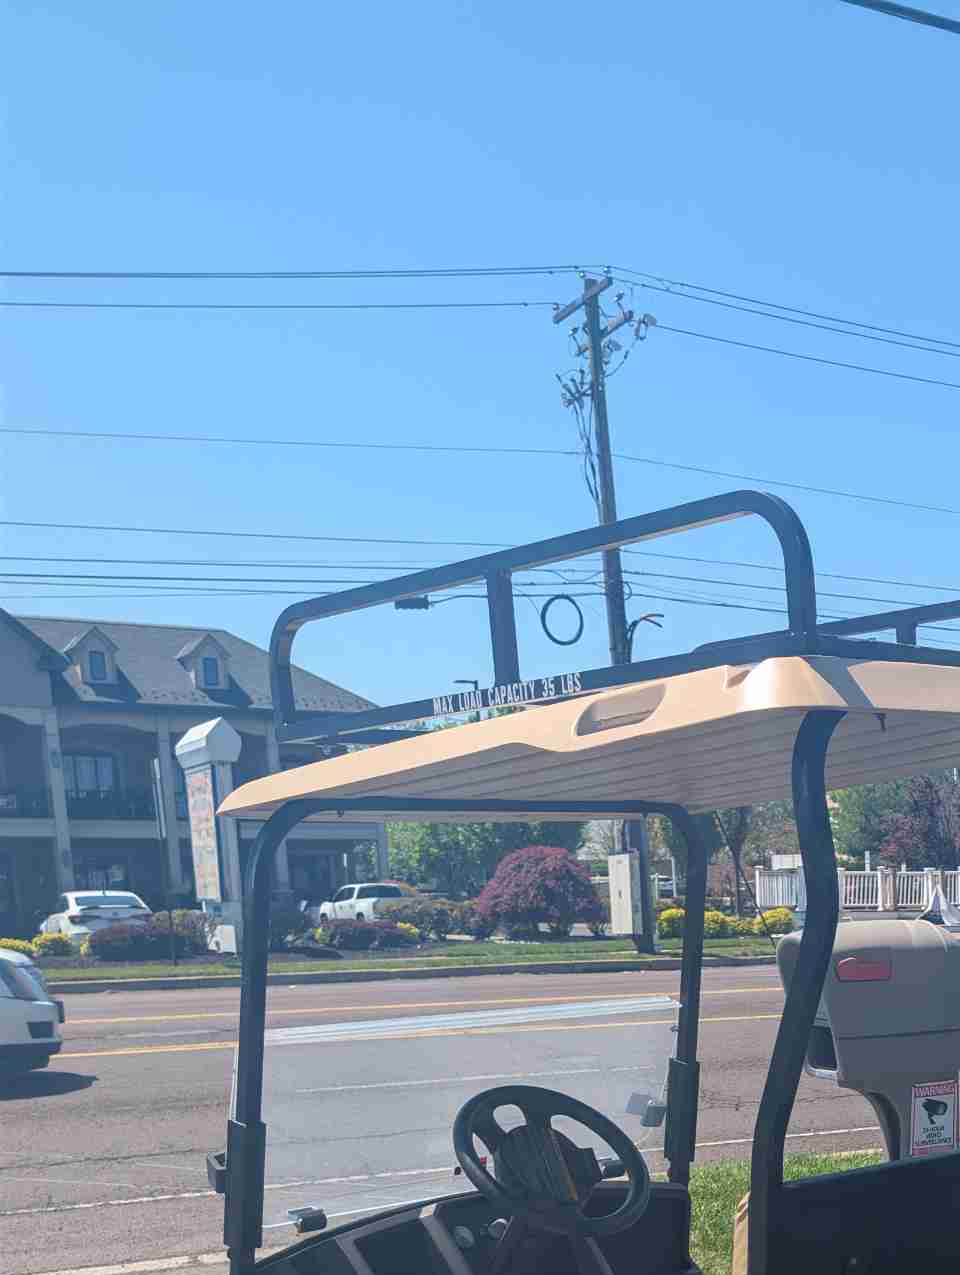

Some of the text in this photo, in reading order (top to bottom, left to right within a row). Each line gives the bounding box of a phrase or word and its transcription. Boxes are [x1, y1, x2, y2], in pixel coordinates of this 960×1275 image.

[432, 672, 582, 713] MAX LOAD CAPACITY 35 LBS
